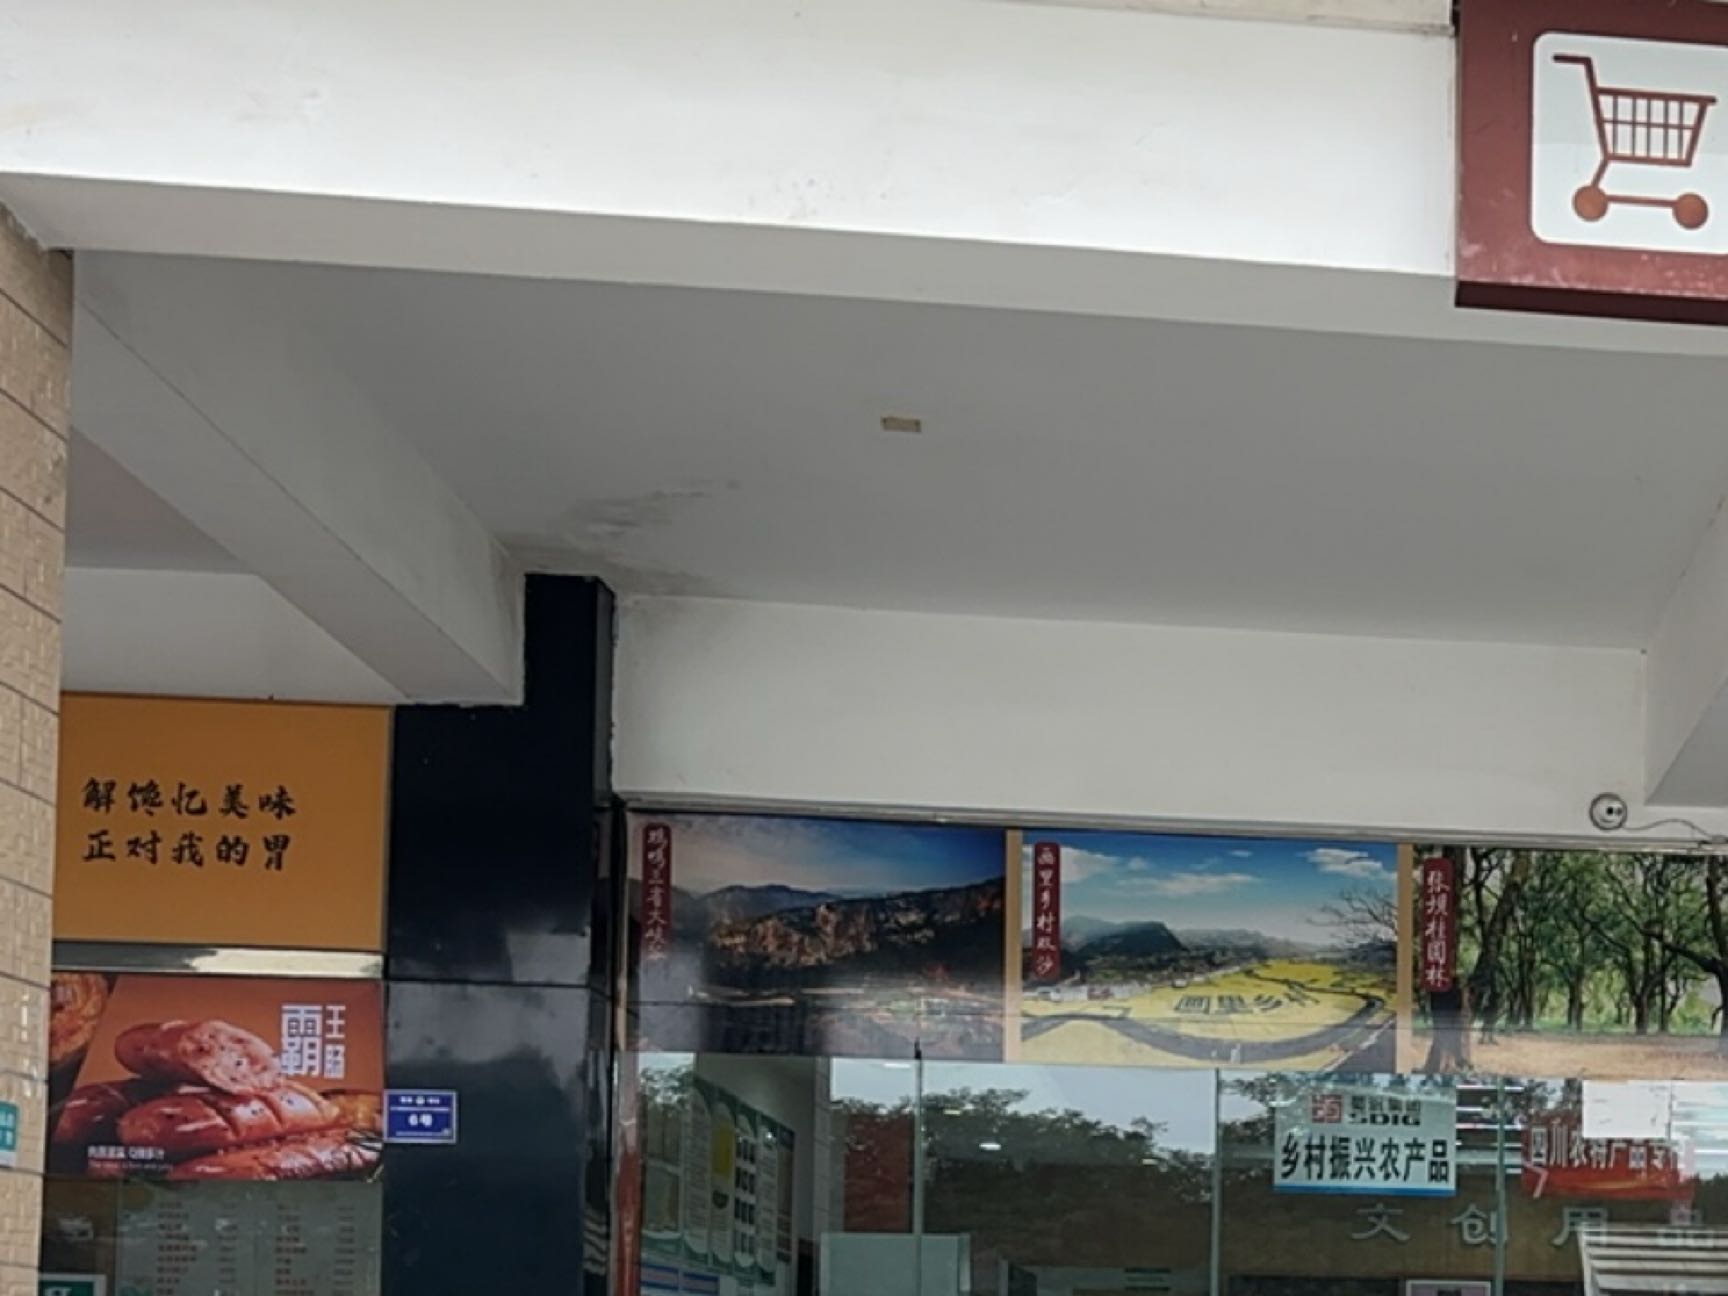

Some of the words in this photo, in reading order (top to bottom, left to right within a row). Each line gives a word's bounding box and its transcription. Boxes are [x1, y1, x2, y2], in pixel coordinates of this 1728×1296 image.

[82, 777, 298, 819] 解馋忆美味
[82, 831, 293, 871] 正对我的胃
[1280, 1132, 1449, 1184] 乡村振兴农产品
[1351, 1202, 1714, 1247] 文创用品
